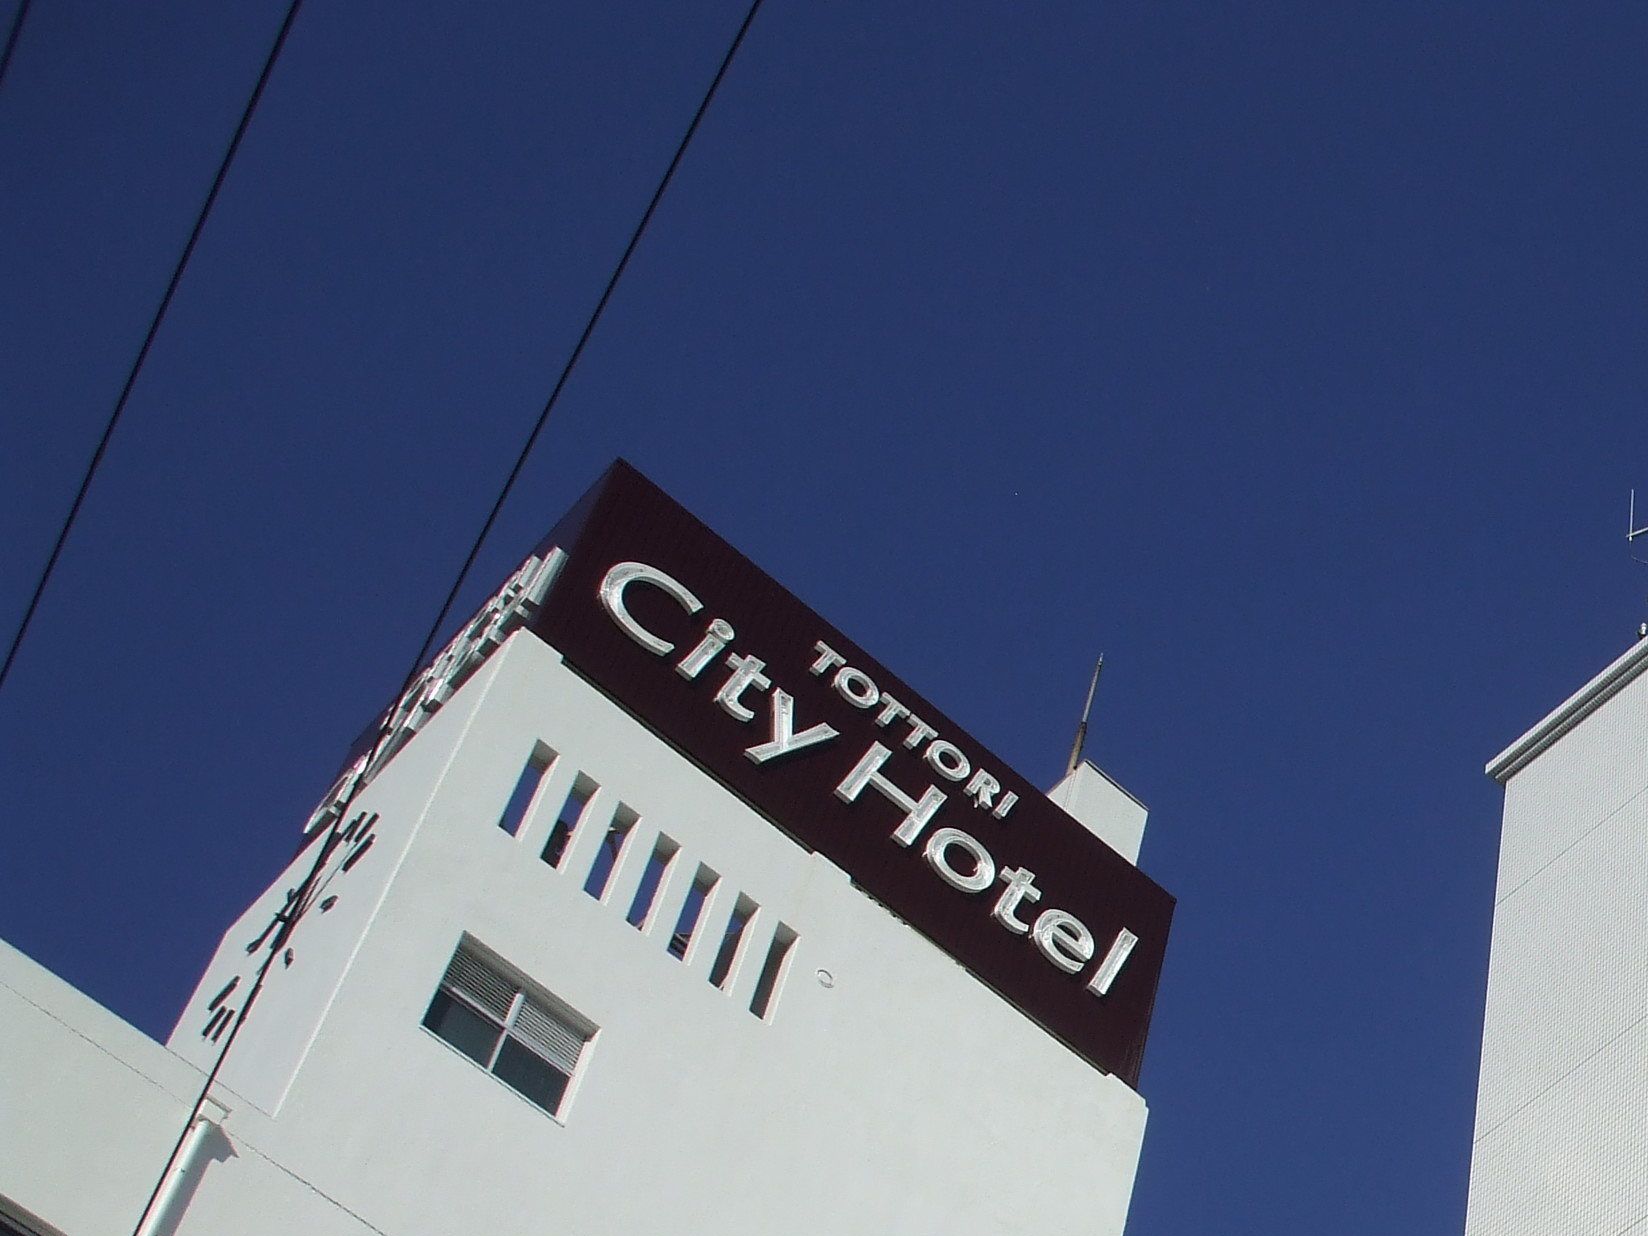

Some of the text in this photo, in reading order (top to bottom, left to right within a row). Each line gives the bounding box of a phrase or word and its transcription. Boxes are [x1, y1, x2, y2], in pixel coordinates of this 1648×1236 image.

[599, 561, 840, 765] City
[834, 740, 1138, 997] Hotel
[809, 640, 1019, 818] TOTTORI
